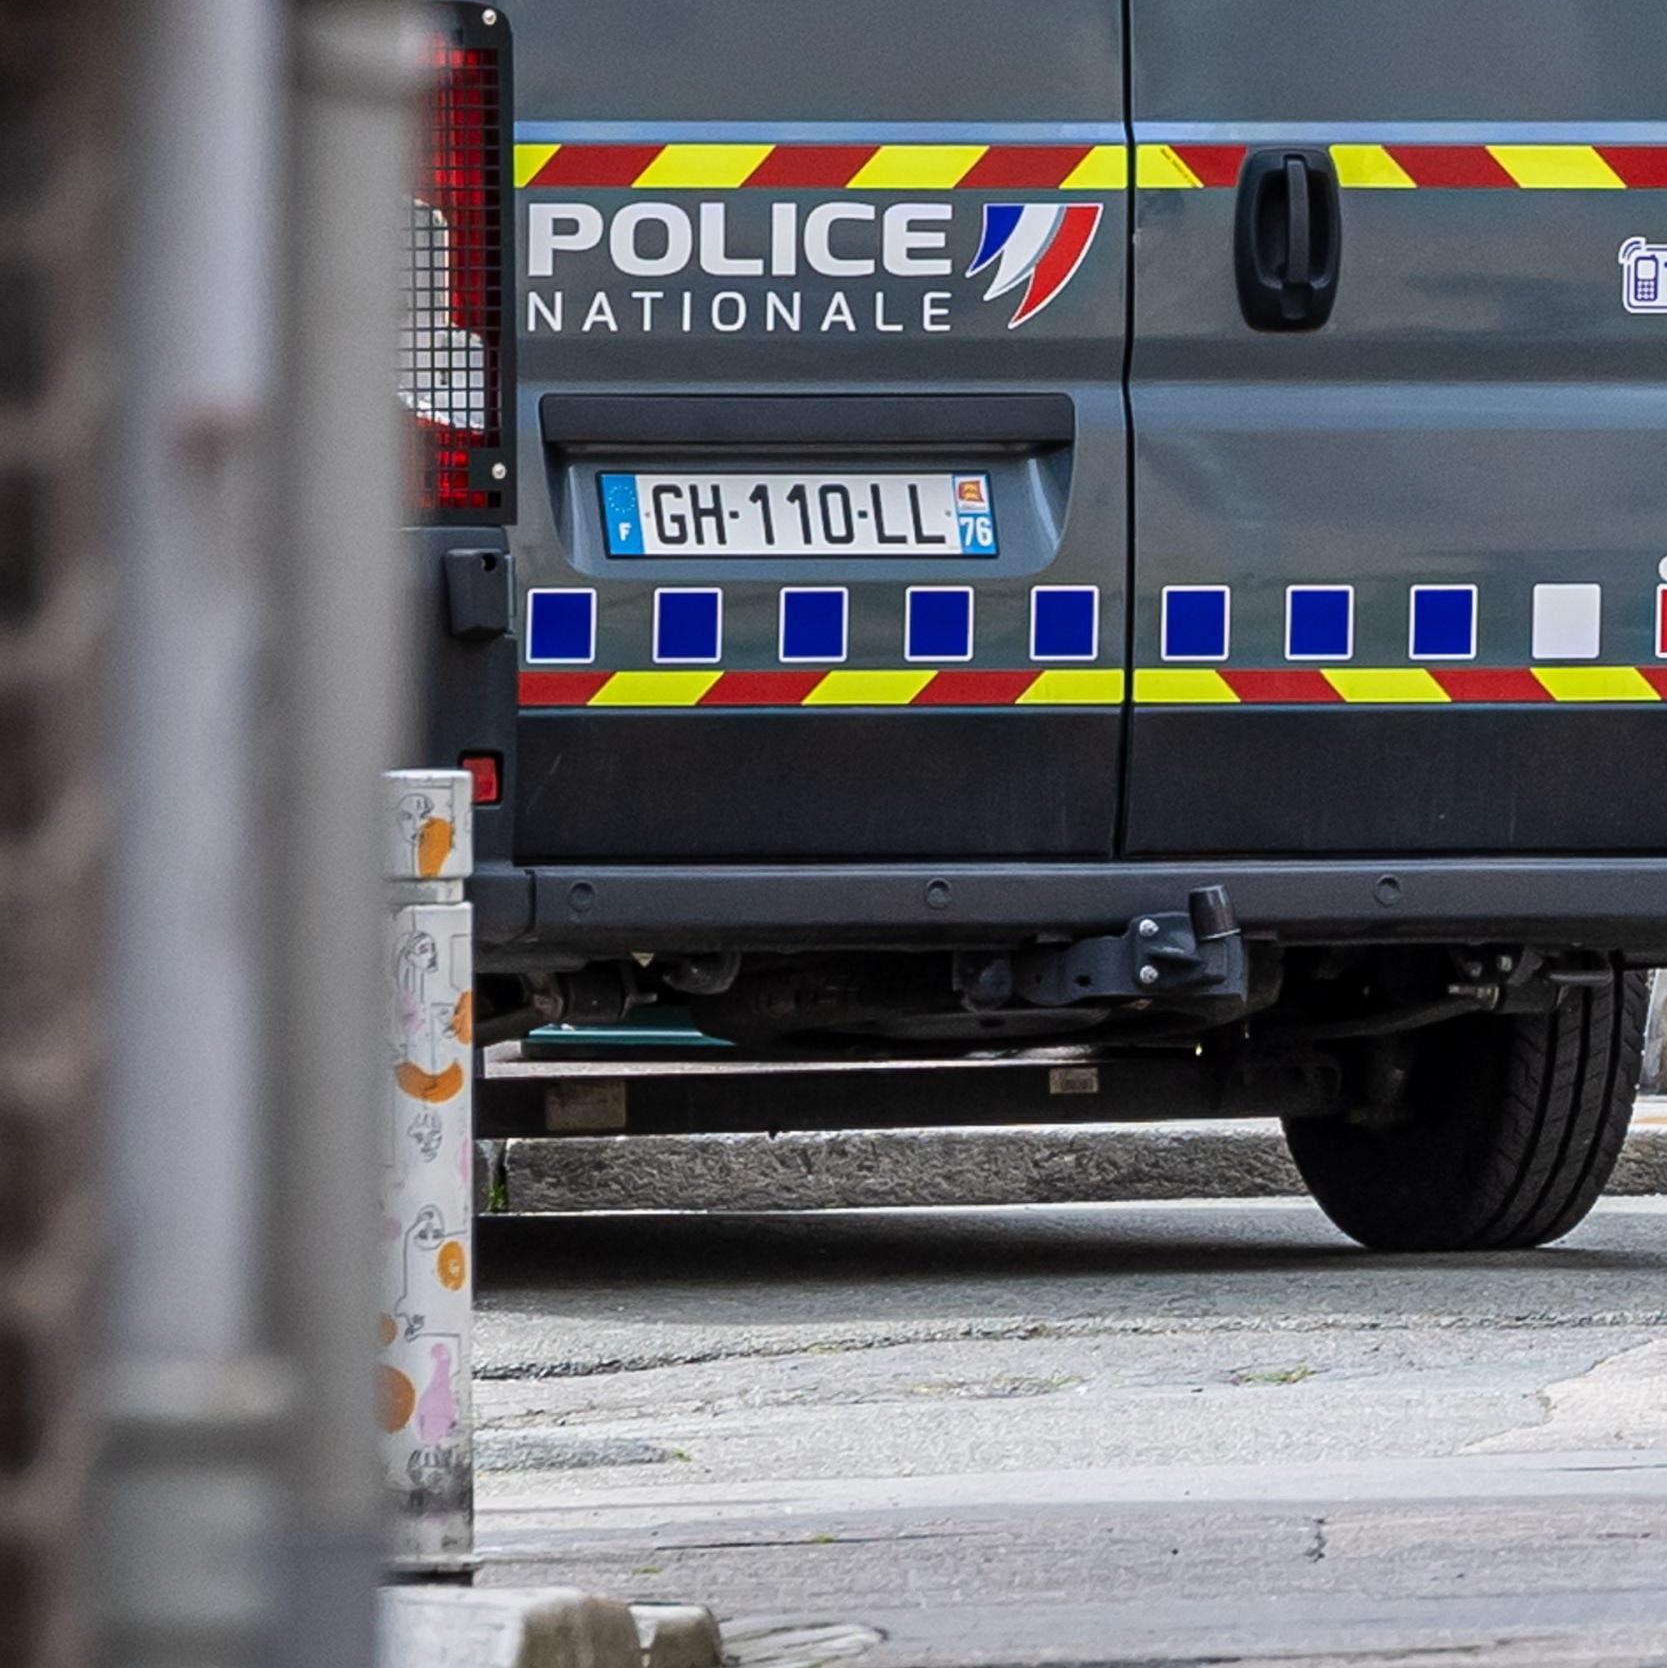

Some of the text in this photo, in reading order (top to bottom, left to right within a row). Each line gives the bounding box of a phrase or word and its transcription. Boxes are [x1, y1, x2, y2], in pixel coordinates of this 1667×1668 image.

[528, 202, 953, 276] POLICE
[528, 291, 952, 332] NATIONALE
[619, 522, 632, 542] F
[651, 484, 946, 545] GH-110-LL
[960, 516, 992, 547] 76
